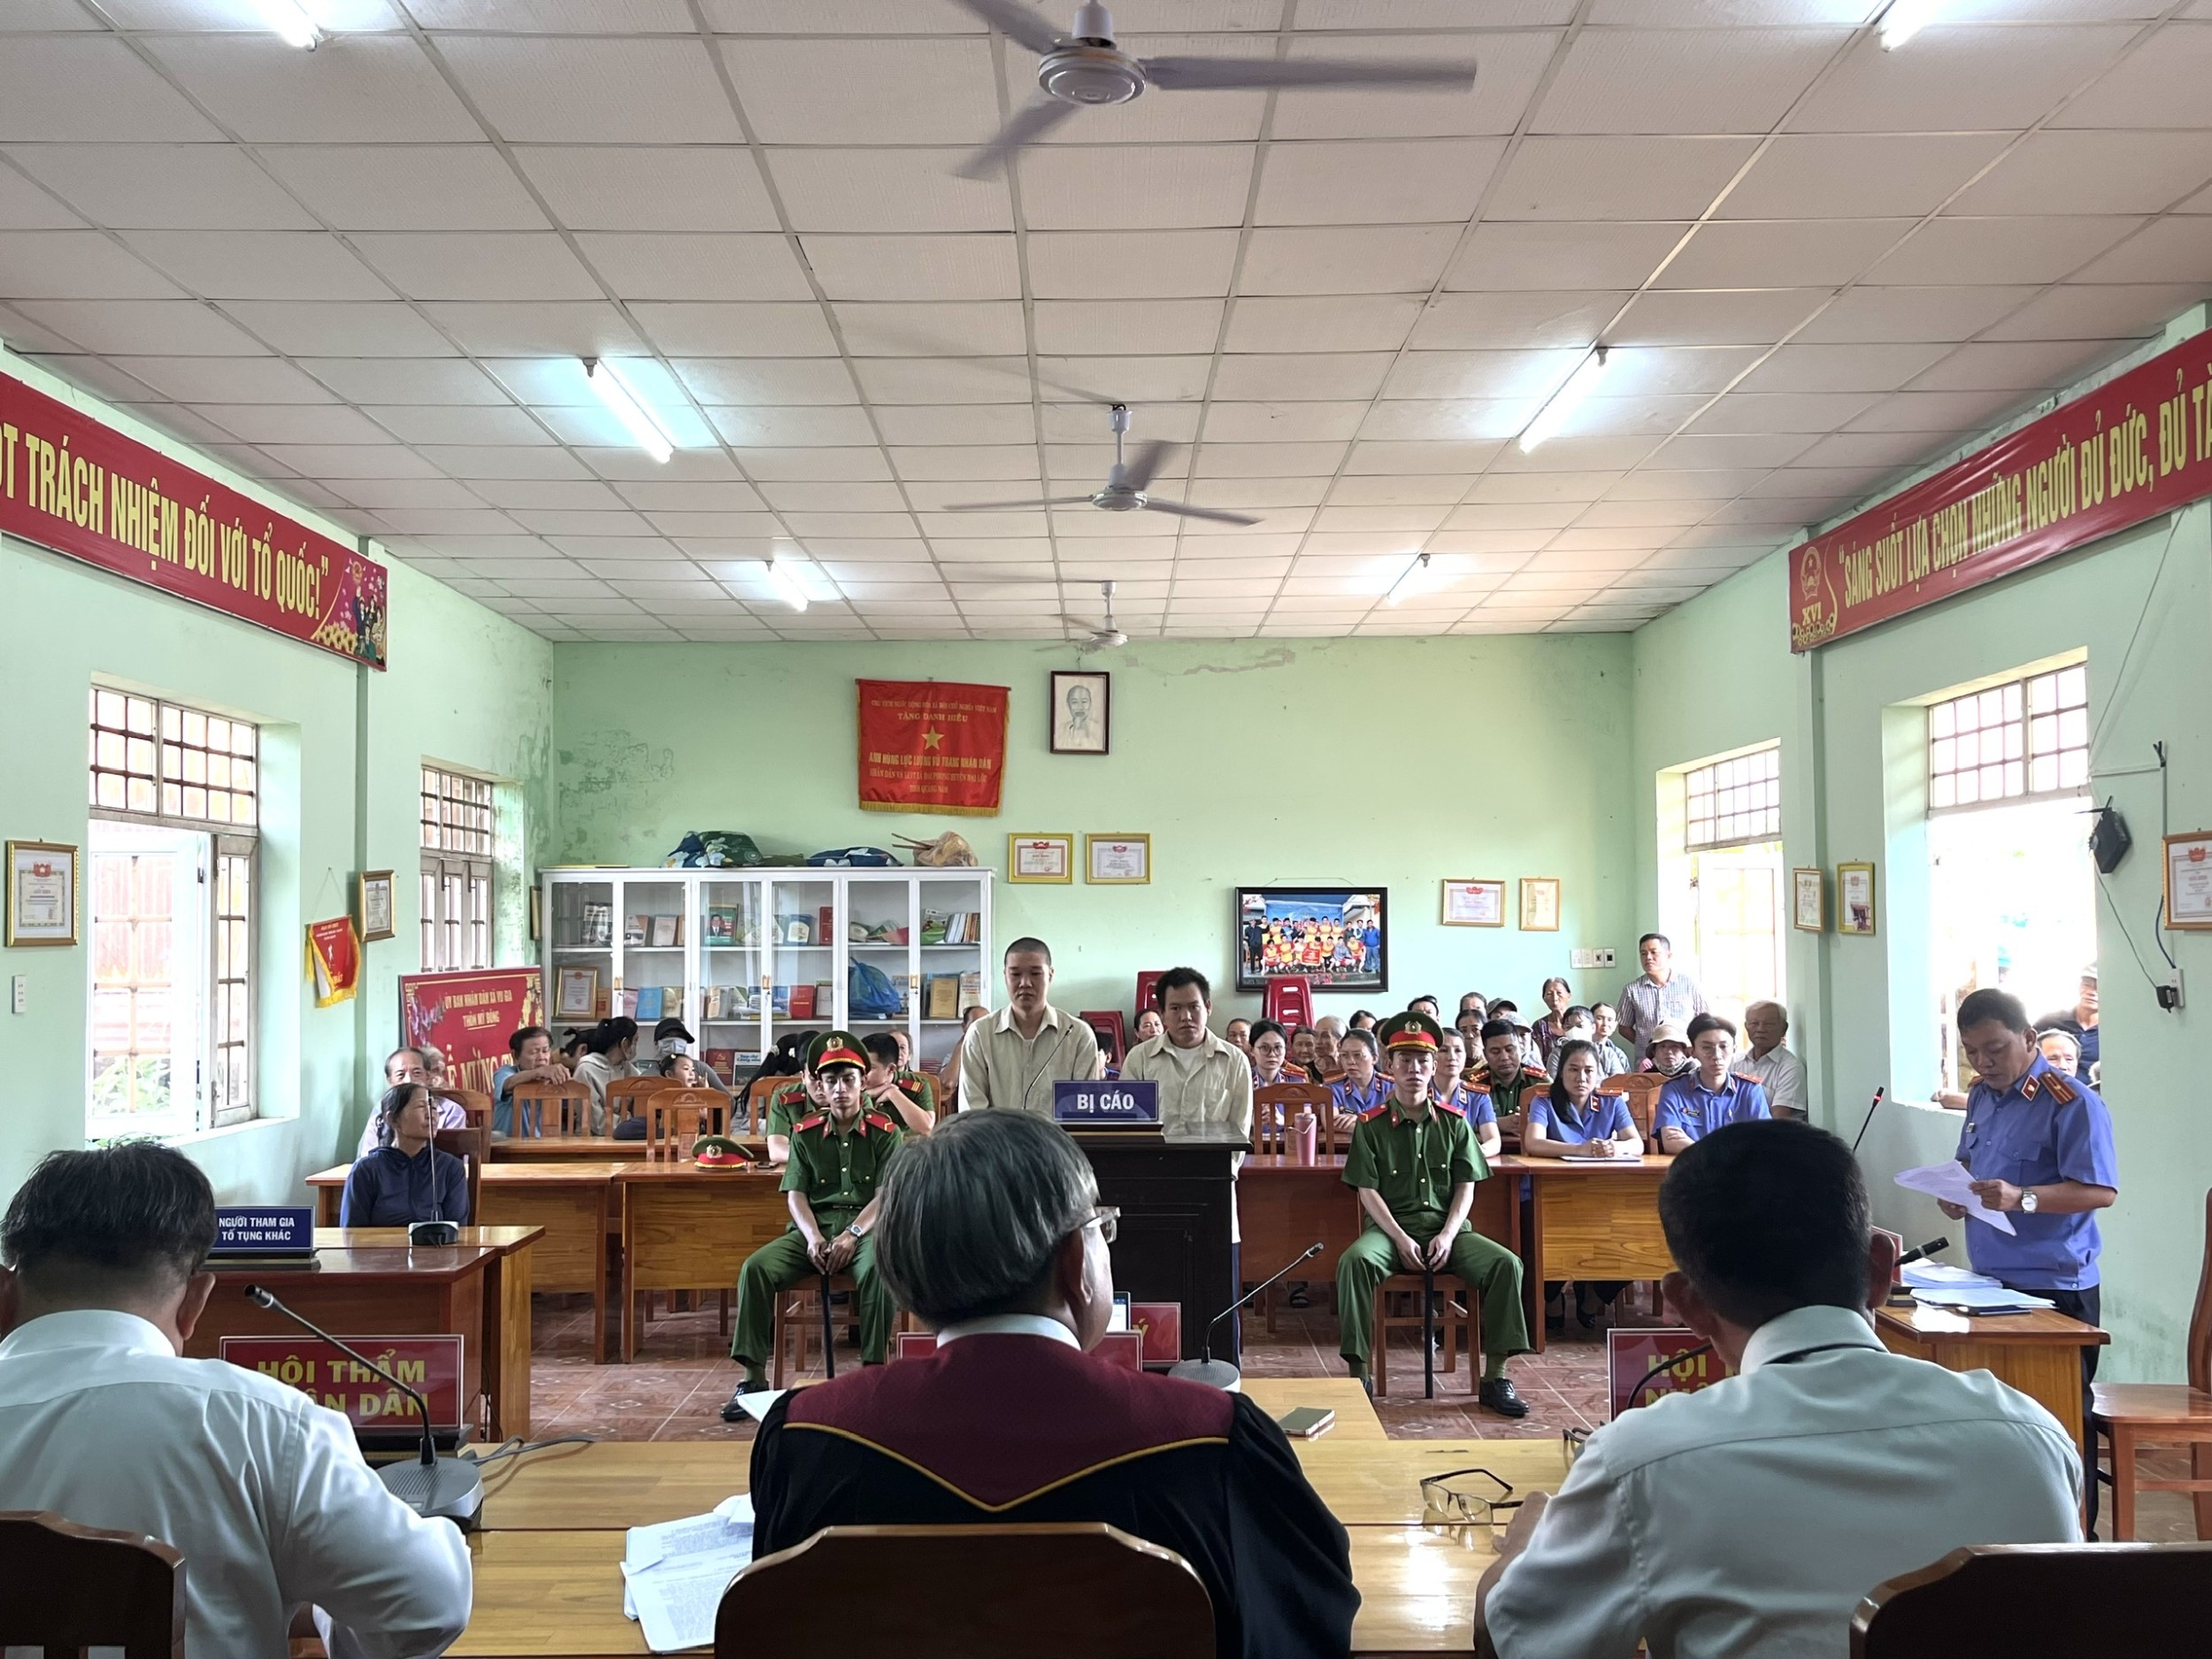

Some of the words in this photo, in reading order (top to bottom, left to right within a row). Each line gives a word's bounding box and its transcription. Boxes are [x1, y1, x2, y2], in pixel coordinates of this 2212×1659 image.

[1875, 512, 1903, 596] SUỐT
[1906, 514, 1930, 593] LỰA
[1932, 499, 1969, 579] CHỌN
[1970, 472, 2023, 556] NHỮNG
[2026, 434, 2077, 534] NGƯỜI
[2080, 410, 2104, 511] ĐỦ
[2109, 403, 2154, 499] ĐỨC,
[2159, 367, 2186, 477] ĐỦ
[0, 422, 19, 499] T
[26, 433, 104, 534] TRÁCH
[111, 472, 179, 571] NHIỆM
[184, 495, 215, 578] ĐỐI
[220, 517, 248, 591] VỚI
[252, 522, 273, 601] TỔ
[1801, 601, 1823, 626] XVI
[923, 712, 946, 721] DANH
[882, 752, 899, 765] HÙNG
[900, 754, 913, 767] LỰC
[941, 756, 960, 768] TRANG
[960, 756, 978, 768] NHÂN
[979, 757, 992, 770] DÂN
[1077, 1094, 1094, 1113] BỊ
[1099, 1089, 1135, 1110] CÁO
[219, 1216, 248, 1227] NGƯỜI
[250, 1217, 277, 1227] THAM
[279, 1217, 295, 1227] GIA
[221, 1228, 235, 1241] TỐ
[237, 1231, 263, 1243] TỤNG
[265, 1229, 291, 1240] KHÁC
[257, 1355, 316, 1387] HỘI
[327, 1348, 426, 1383] THẨM
[1647, 1348, 1707, 1382] HỘI
[359, 1389, 428, 1416] DÂN
